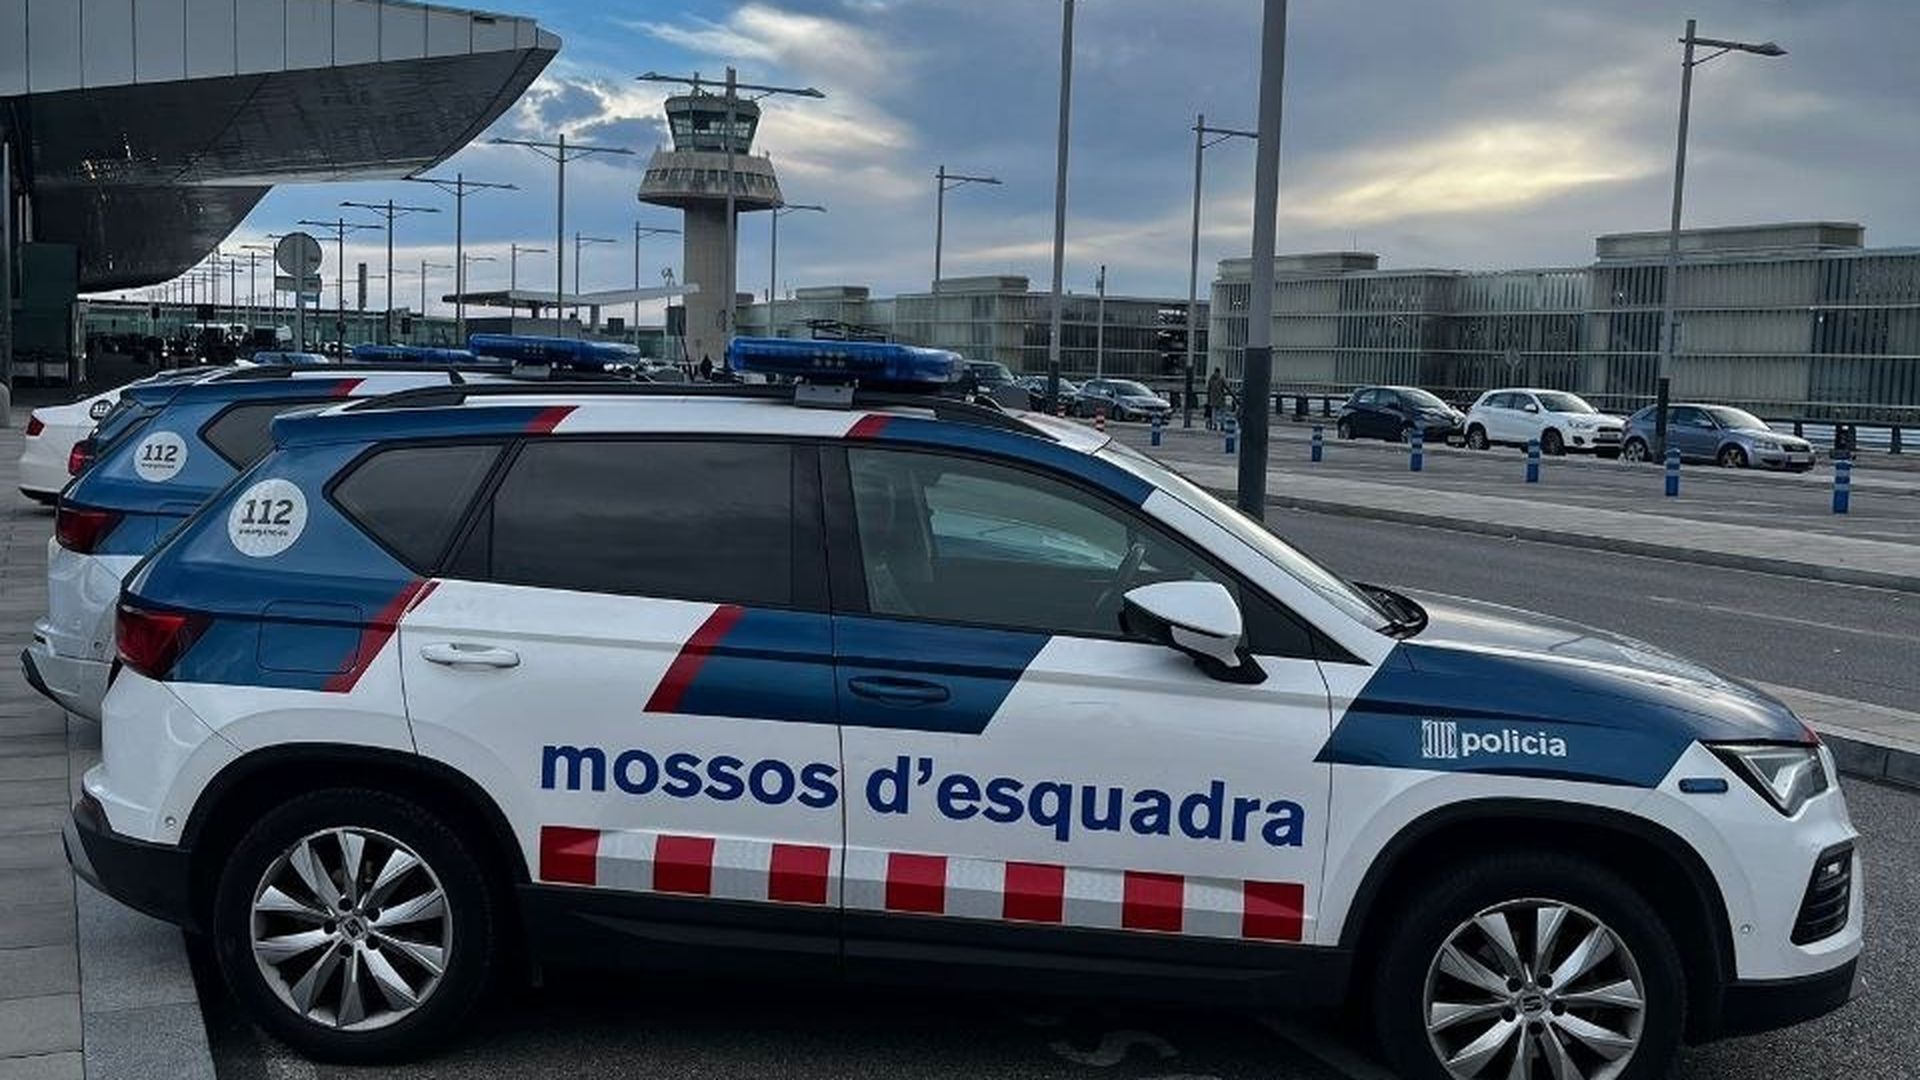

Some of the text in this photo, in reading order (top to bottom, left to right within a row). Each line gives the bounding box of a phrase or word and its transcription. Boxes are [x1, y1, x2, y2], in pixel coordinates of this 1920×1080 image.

[142, 444, 178, 462] 112
[241, 499, 294, 525] 112
[1461, 729, 1567, 757] policia
[541, 745, 1305, 847] mossos d’esquadra
